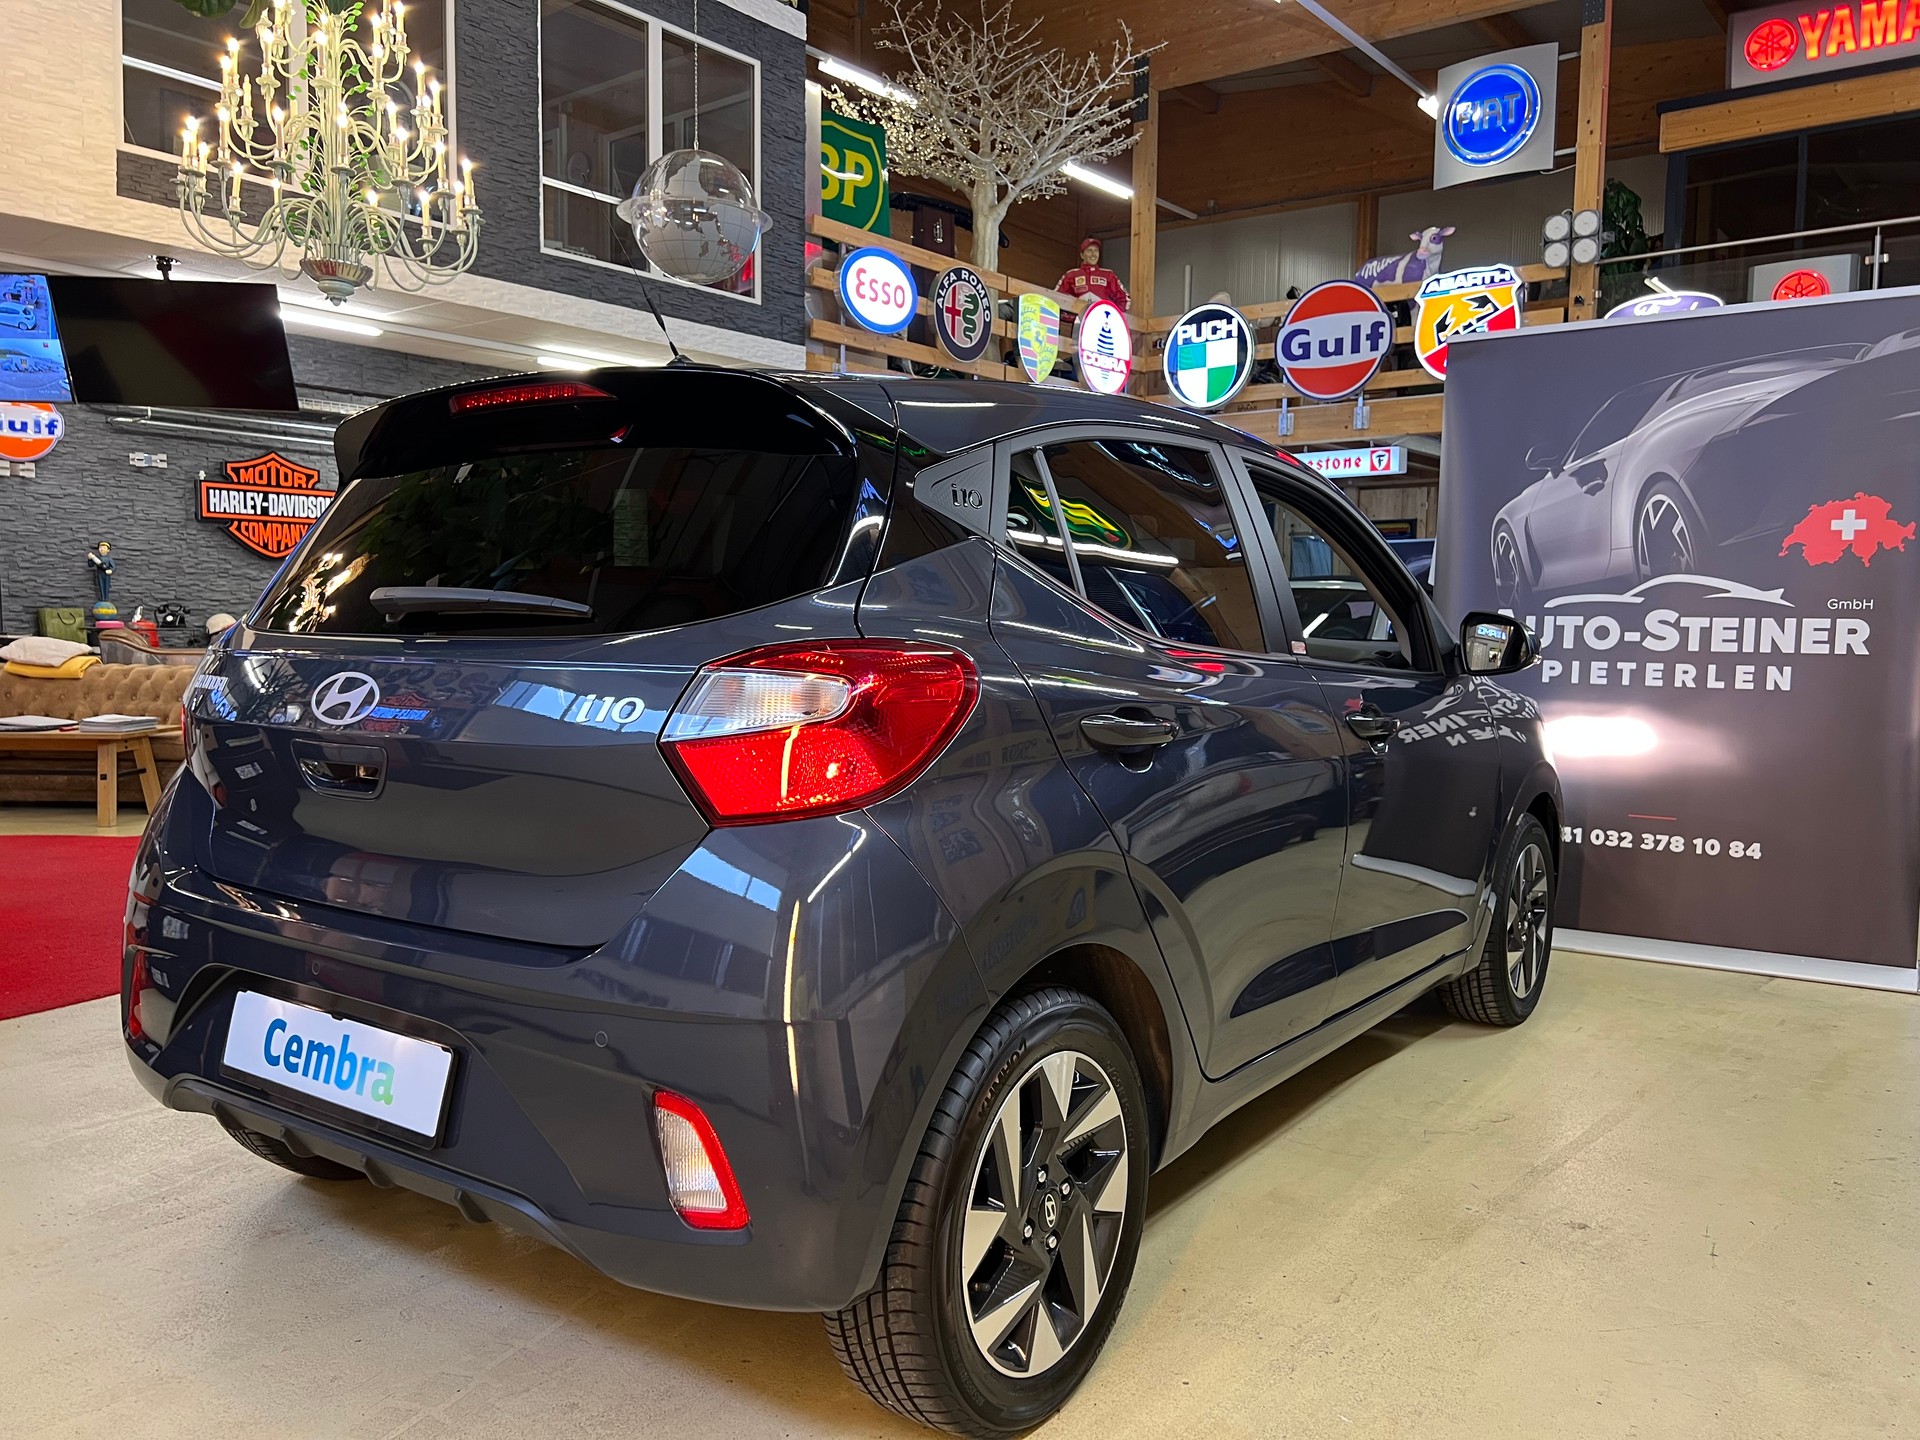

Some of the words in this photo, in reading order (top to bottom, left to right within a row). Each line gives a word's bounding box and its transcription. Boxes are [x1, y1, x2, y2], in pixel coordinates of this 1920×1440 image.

[1456, 93, 1520, 134] FIAT
[936, 270, 958, 310] ALFA
[961, 269, 991, 323] ROMEO
[1425, 269, 1511, 294] ABARTH
[1177, 318, 1238, 346] PUCH
[1281, 321, 1386, 362] Gulf
[1082, 350, 1128, 374] COBRA
[0, 418, 59, 436] ulf
[240, 460, 307, 489] MOTOR
[1827, 598, 1874, 611] GmbH
[1497, 608, 1871, 656] UTO-STEINER
[1541, 659, 1792, 692] PIETERLEN
[576, 693, 645, 724] i10
[1590, 829, 1633, 848] 032
[1640, 833, 1685, 853] 378
[1692, 838, 1721, 856] 10
[1728, 841, 1762, 860] 84
[263, 1018, 395, 1106] Cembra
